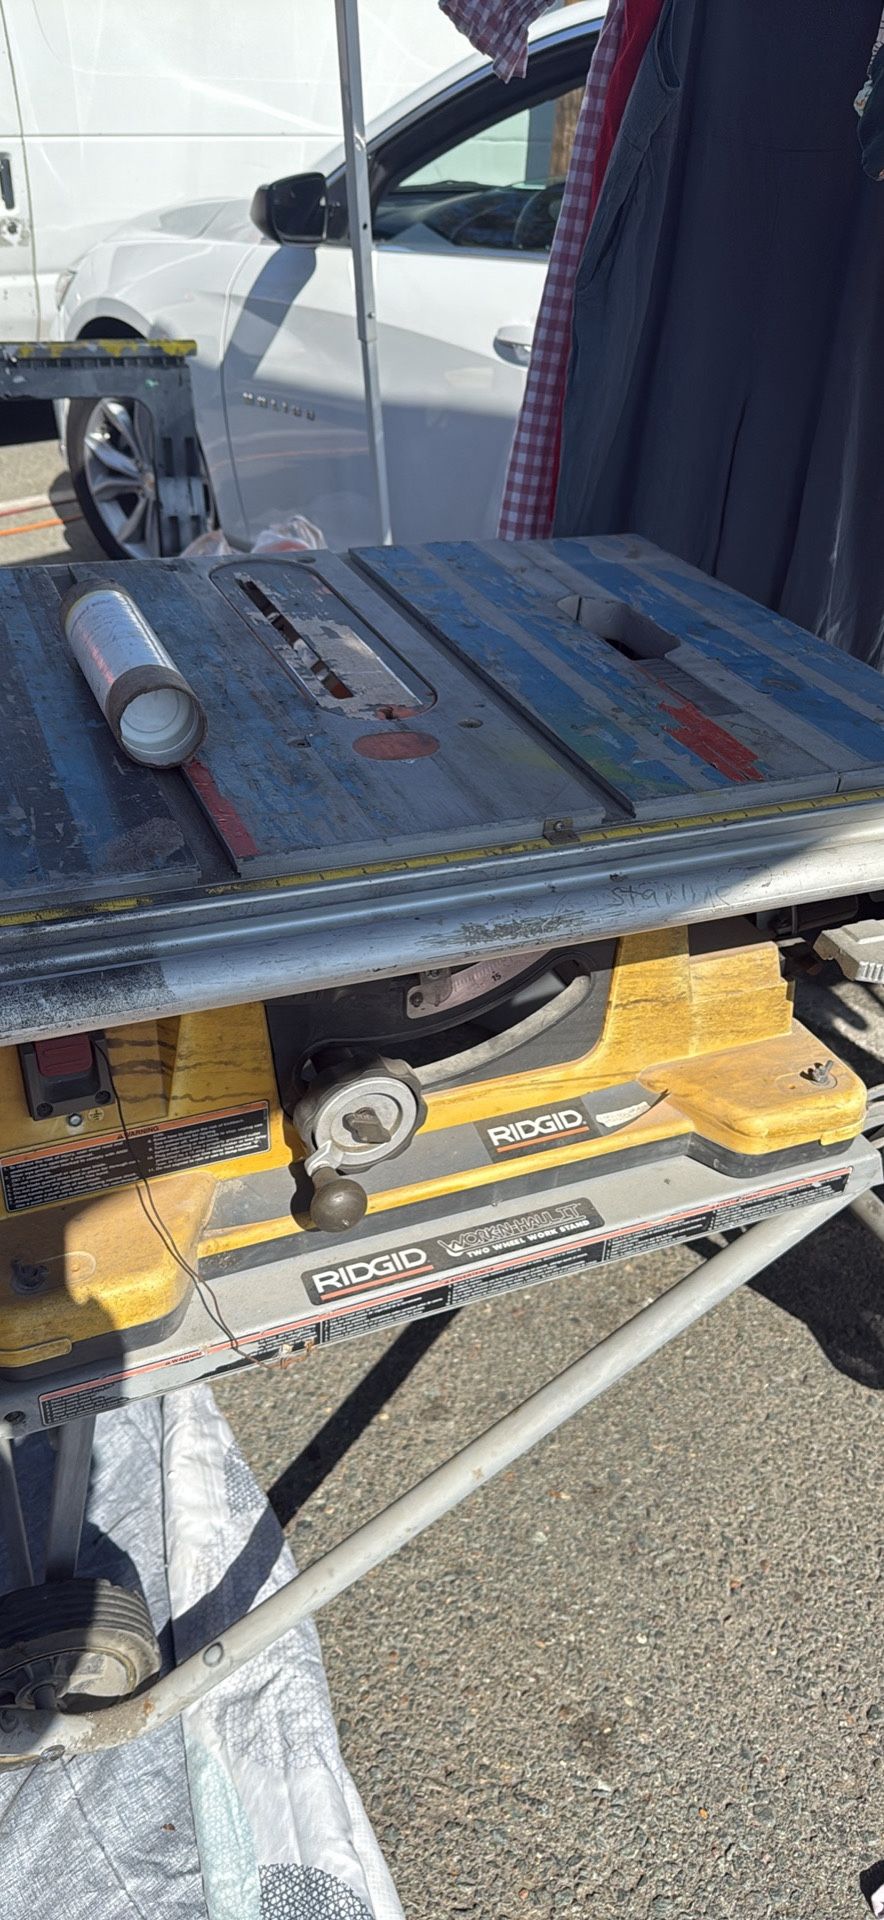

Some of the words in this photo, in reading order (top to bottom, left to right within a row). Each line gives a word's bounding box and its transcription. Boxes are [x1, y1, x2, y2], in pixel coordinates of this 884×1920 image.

[487, 1109, 583, 1146] RIDGID
[466, 1247, 490, 1258] TWO
[492, 1238, 525, 1250] WHEEL
[527, 1230, 558, 1240] WORK
[560, 1220, 590, 1232] STAND
[312, 1248, 427, 1294] RIDGID
